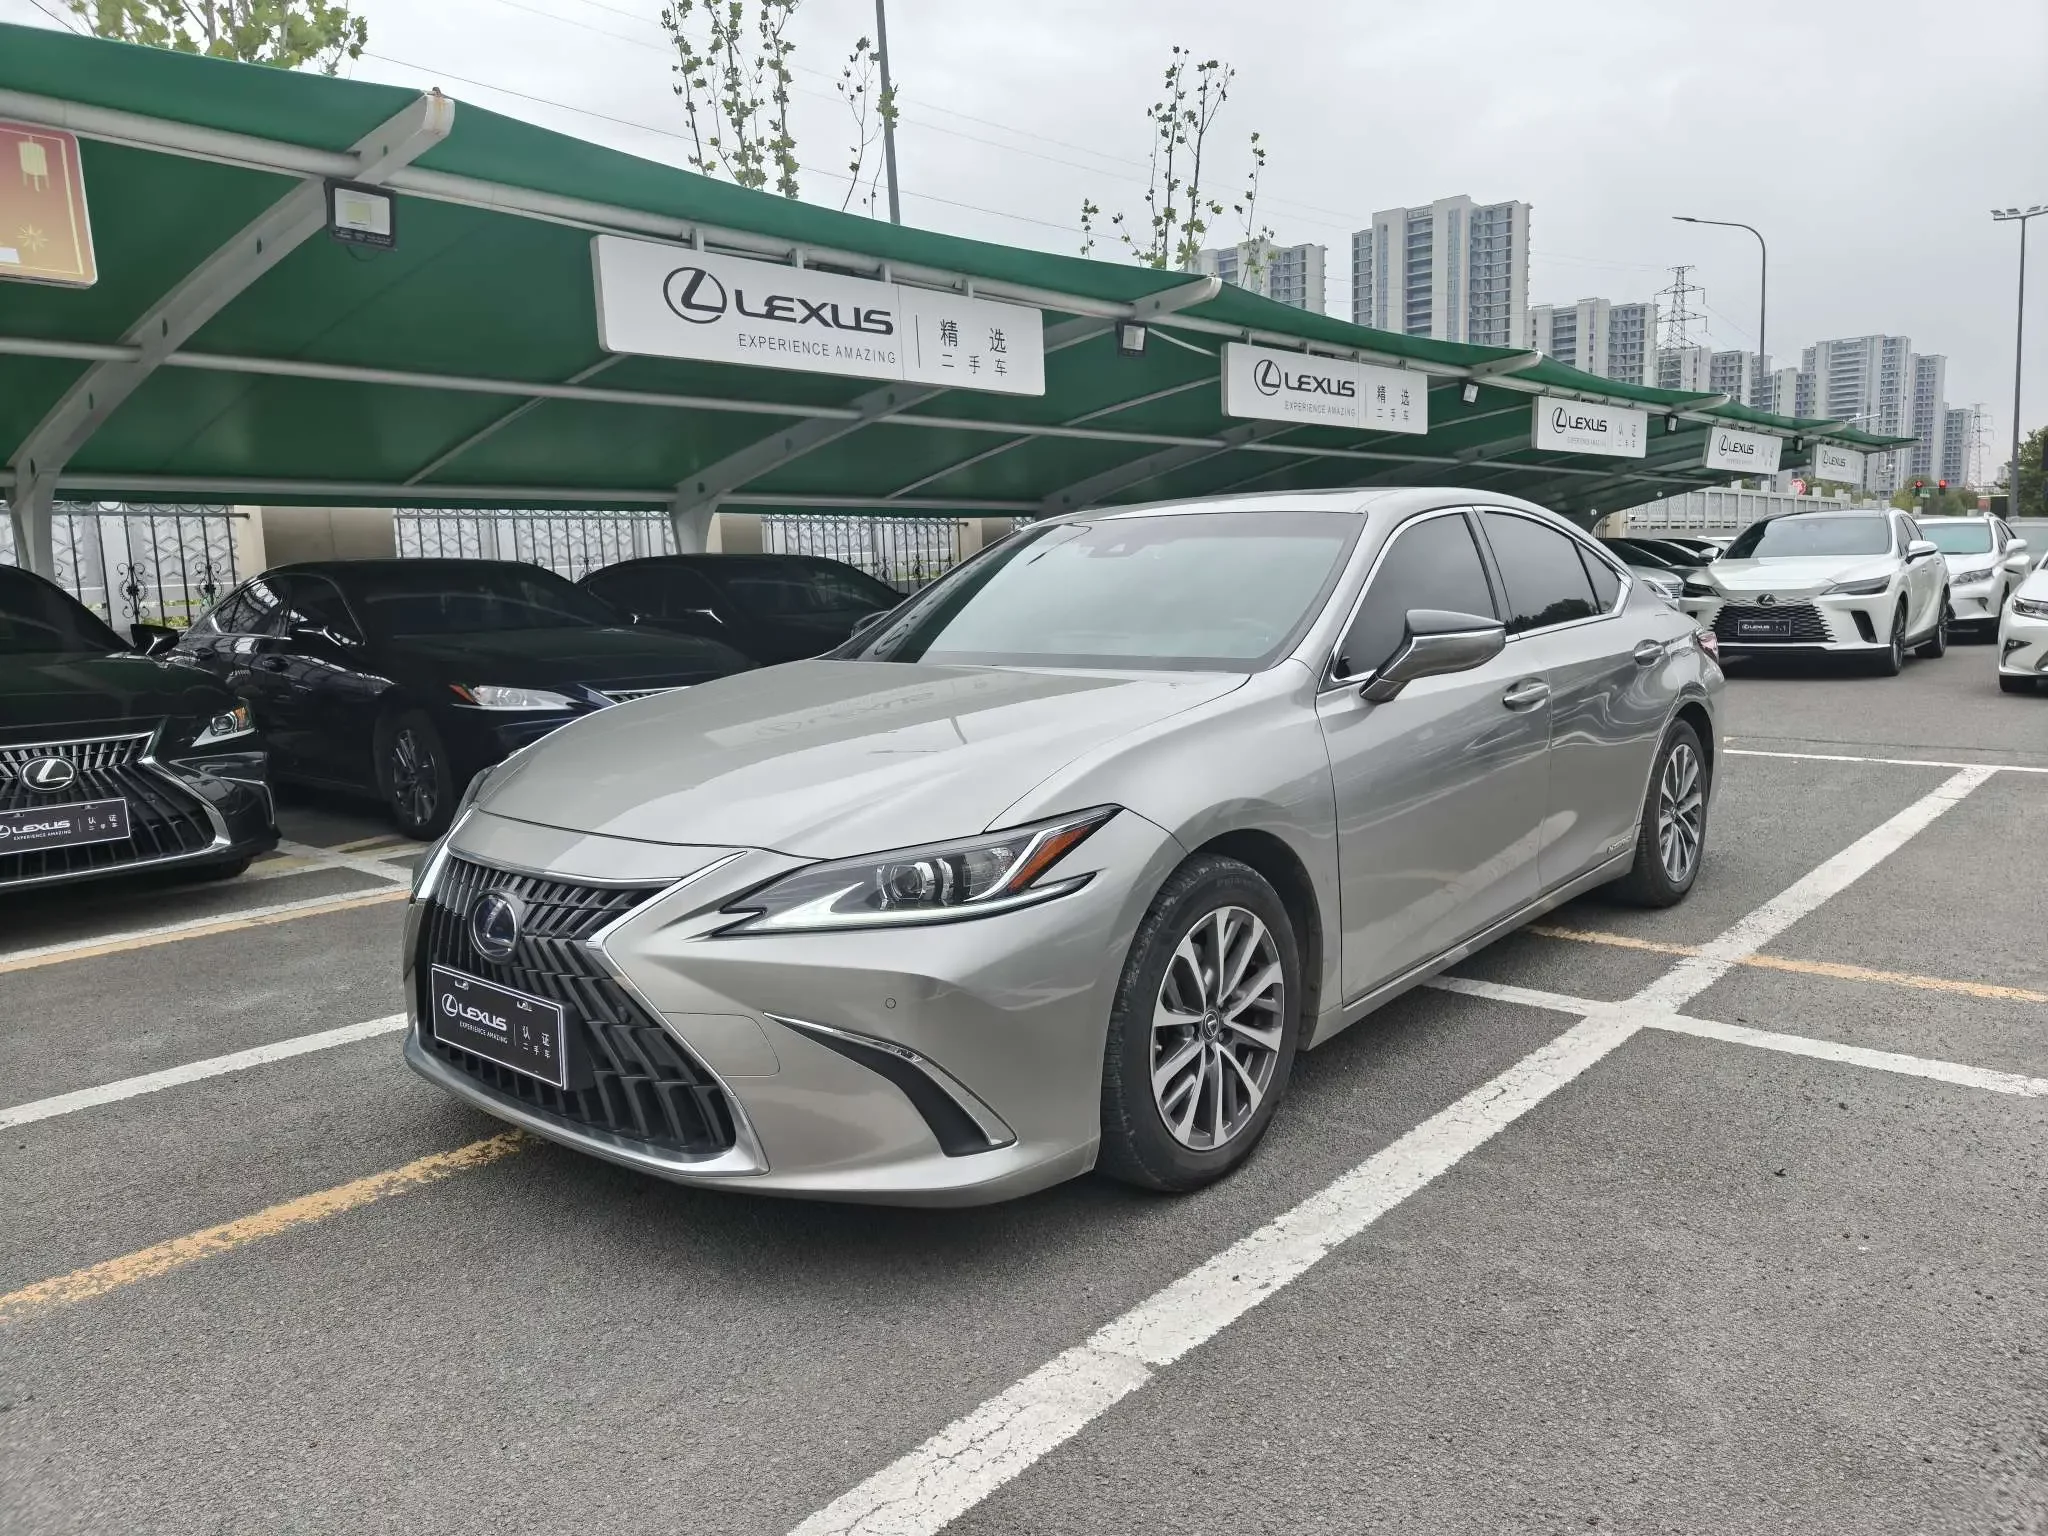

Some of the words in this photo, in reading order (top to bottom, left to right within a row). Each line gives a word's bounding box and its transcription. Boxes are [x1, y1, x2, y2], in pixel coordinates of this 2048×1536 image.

[735, 289, 894, 336] LEXUS
[738, 333, 830, 357] EXPERIENCE
[835, 345, 896, 364] AMAZING
[939, 319, 1008, 355] 精选
[941, 353, 1008, 377] 二手车
[1284, 372, 1355, 398] LEXUS
[1284, 400, 1326, 414] EXPERIENCE
[1327, 405, 1356, 417] AMAZING
[1568, 415, 1607, 432] LEXUS
[1728, 441, 1755, 455] LEXUS
[1828, 456, 1847, 467] LEXUS
[12, 820, 71, 834] LEXUS
[13, 832, 46, 841] EXPERIENCE
[47, 829, 72, 838] AMAZING
[458, 1003, 508, 1032] LEXUS
[459, 1020, 486, 1037] EXPERIENCE
[486, 1030, 508, 1045] AMAZING
